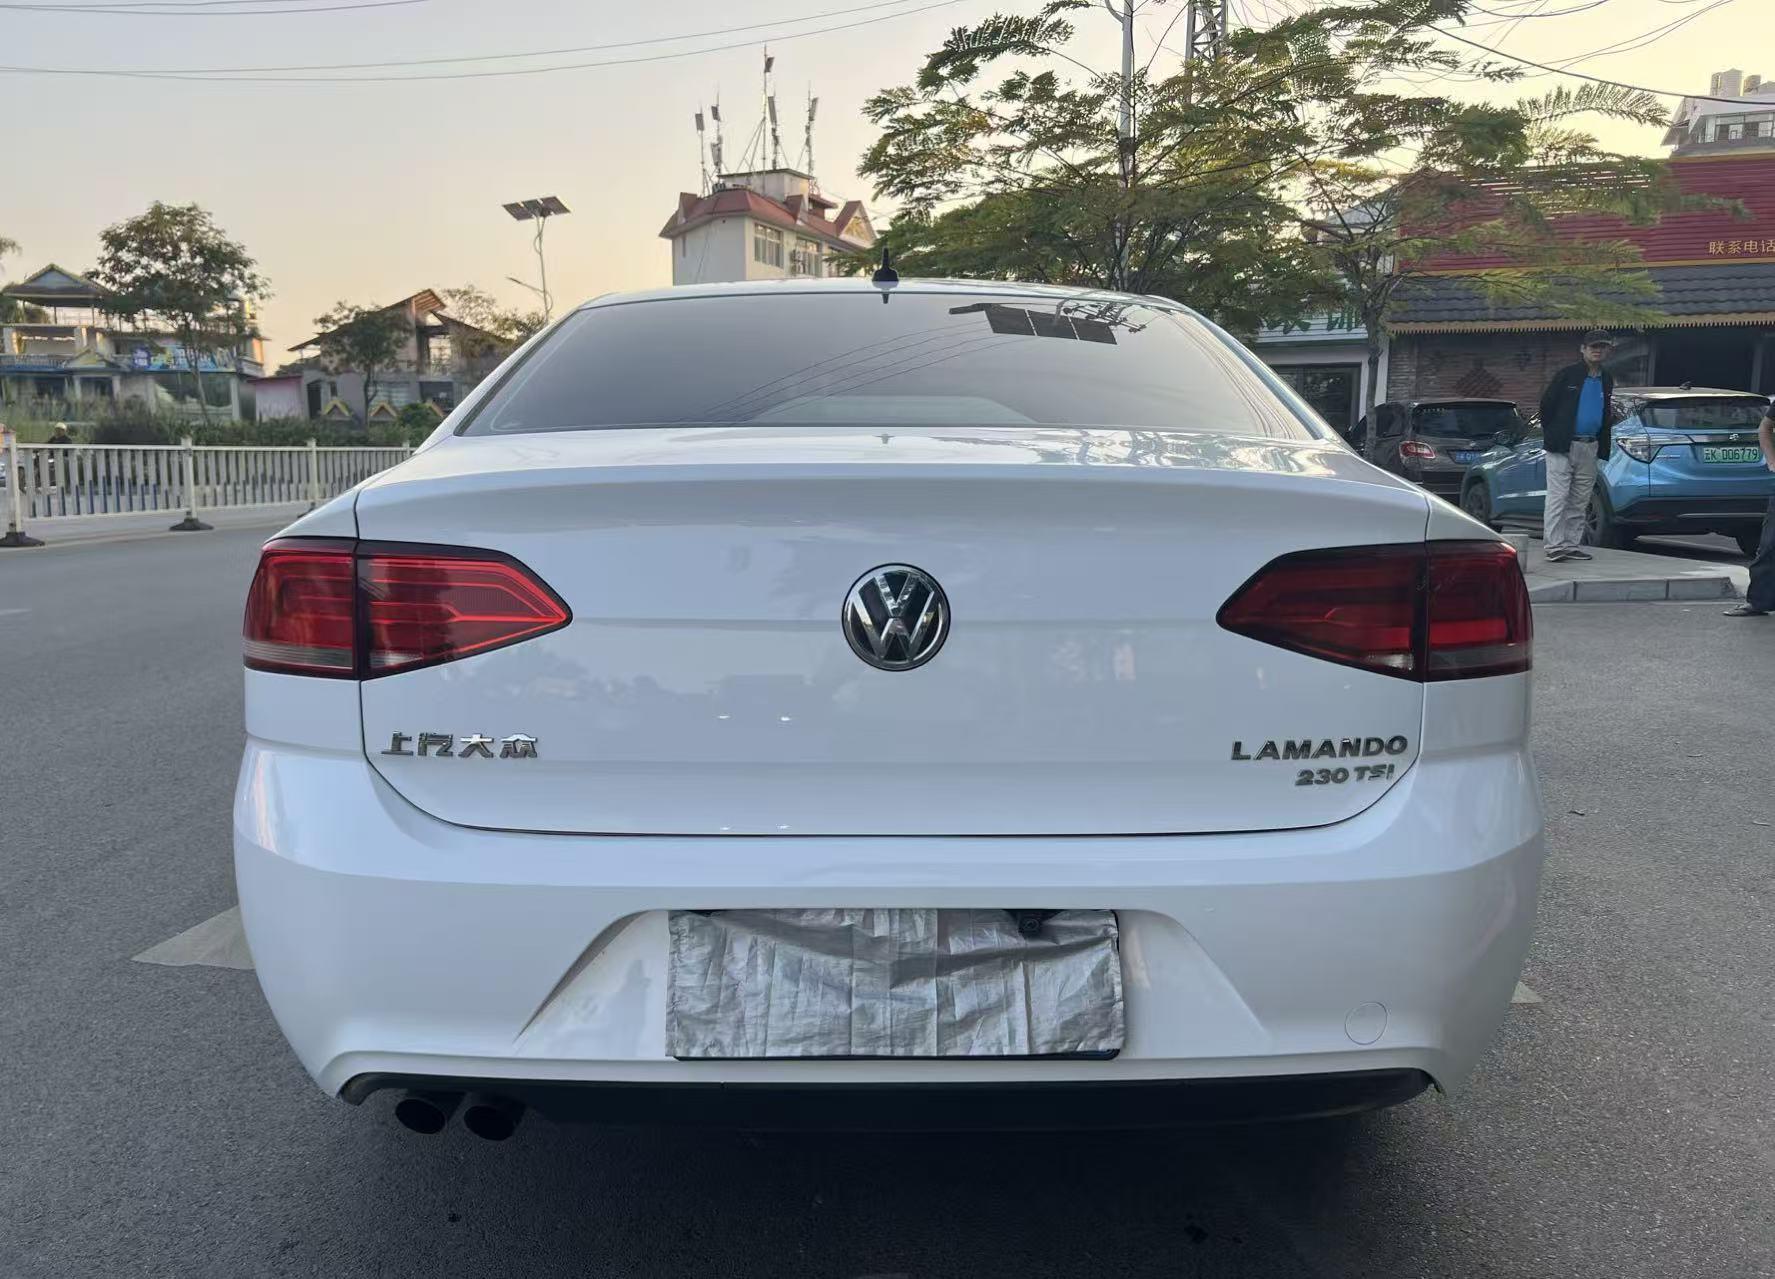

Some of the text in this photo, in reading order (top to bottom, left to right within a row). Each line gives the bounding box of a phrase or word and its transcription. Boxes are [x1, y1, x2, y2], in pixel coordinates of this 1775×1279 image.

[1709, 240, 1775, 254] 联系电话
[381, 731, 538, 758] 上汽大众
[1231, 736, 1408, 760] LAMANDO
[1295, 764, 1395, 786] 230 TSI
